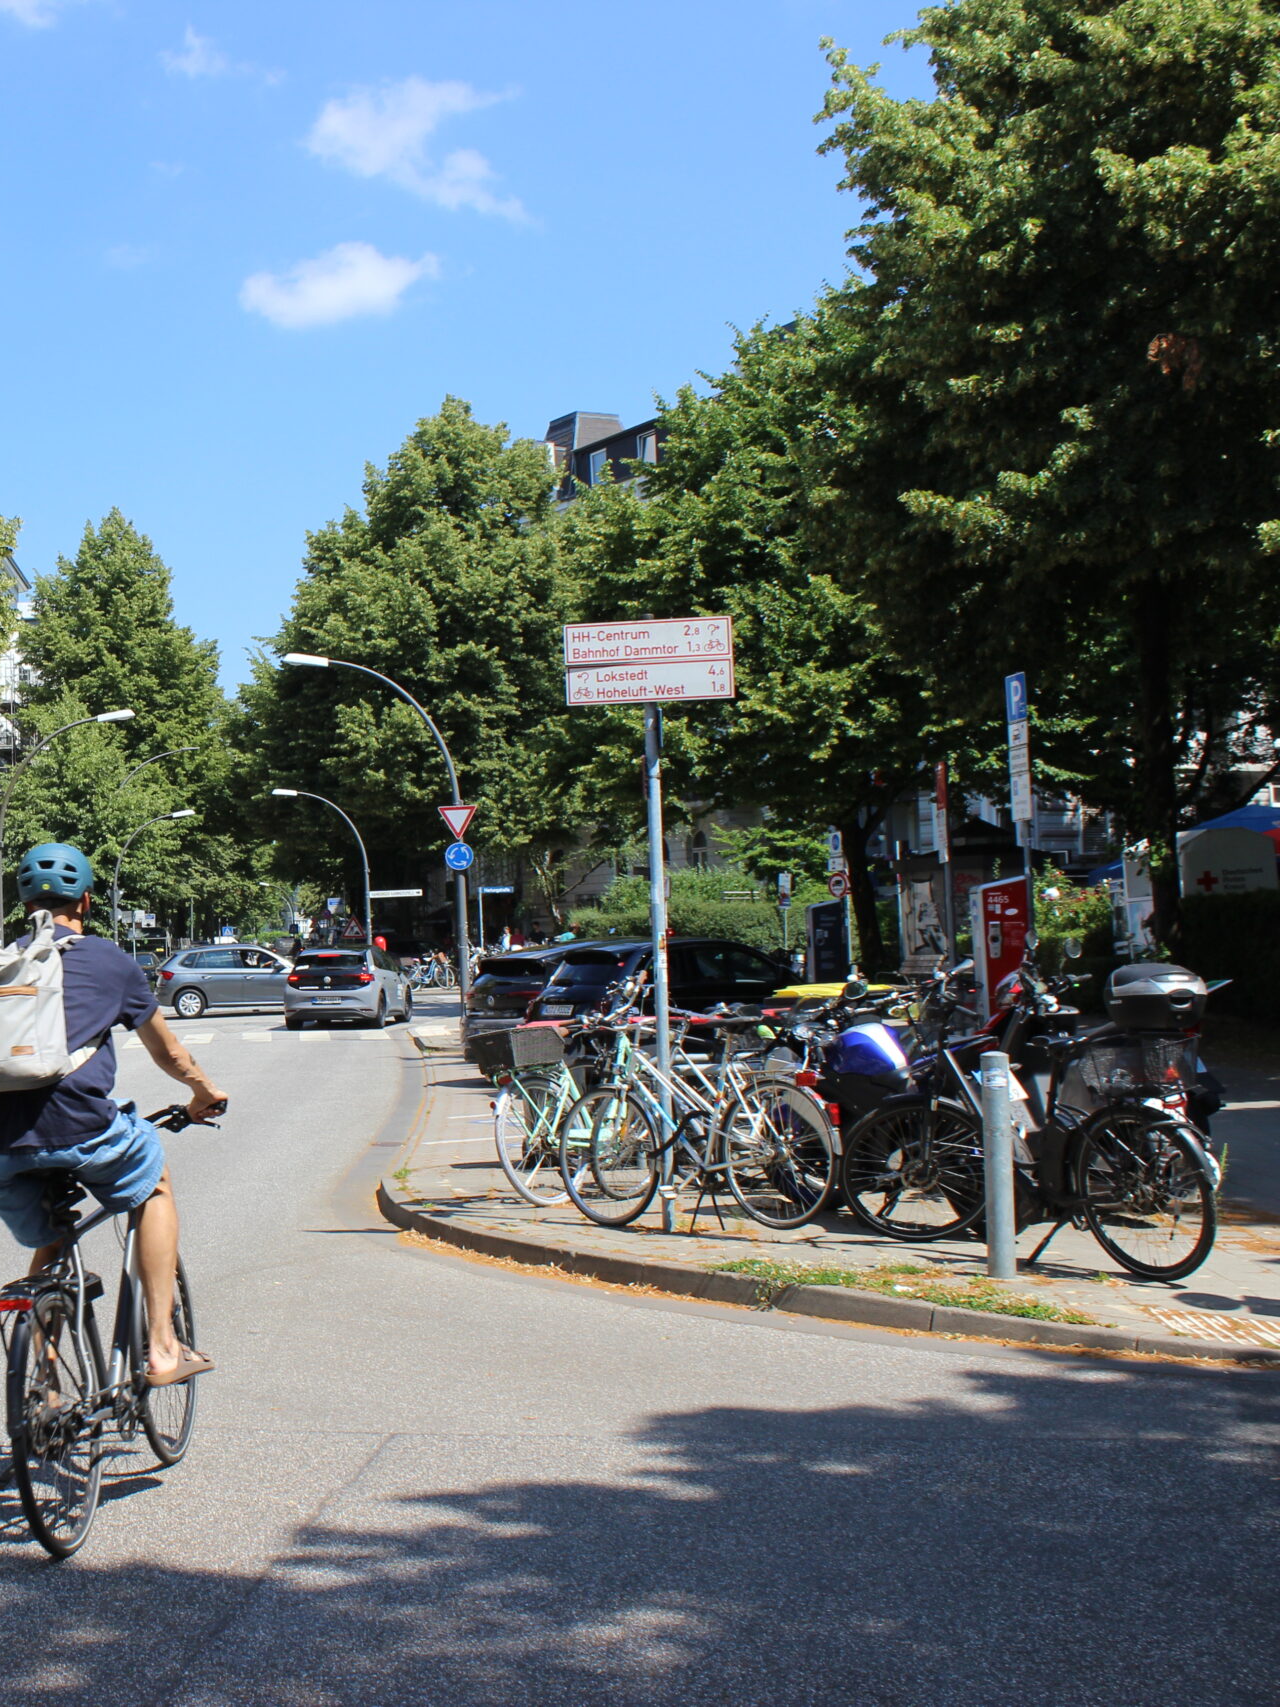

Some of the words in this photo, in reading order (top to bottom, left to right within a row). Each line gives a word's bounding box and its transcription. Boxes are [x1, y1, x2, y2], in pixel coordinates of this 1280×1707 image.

[572, 629, 650, 643] HH-Centrum
[572, 645, 620, 660] Bahnhof
[624, 644, 679, 657] Dammtor
[596, 669, 648, 683] Lokstedt
[596, 684, 685, 699] Hoheluft-West
[1010, 680, 1022, 715] P
[987, 895, 1009, 903] 4465
